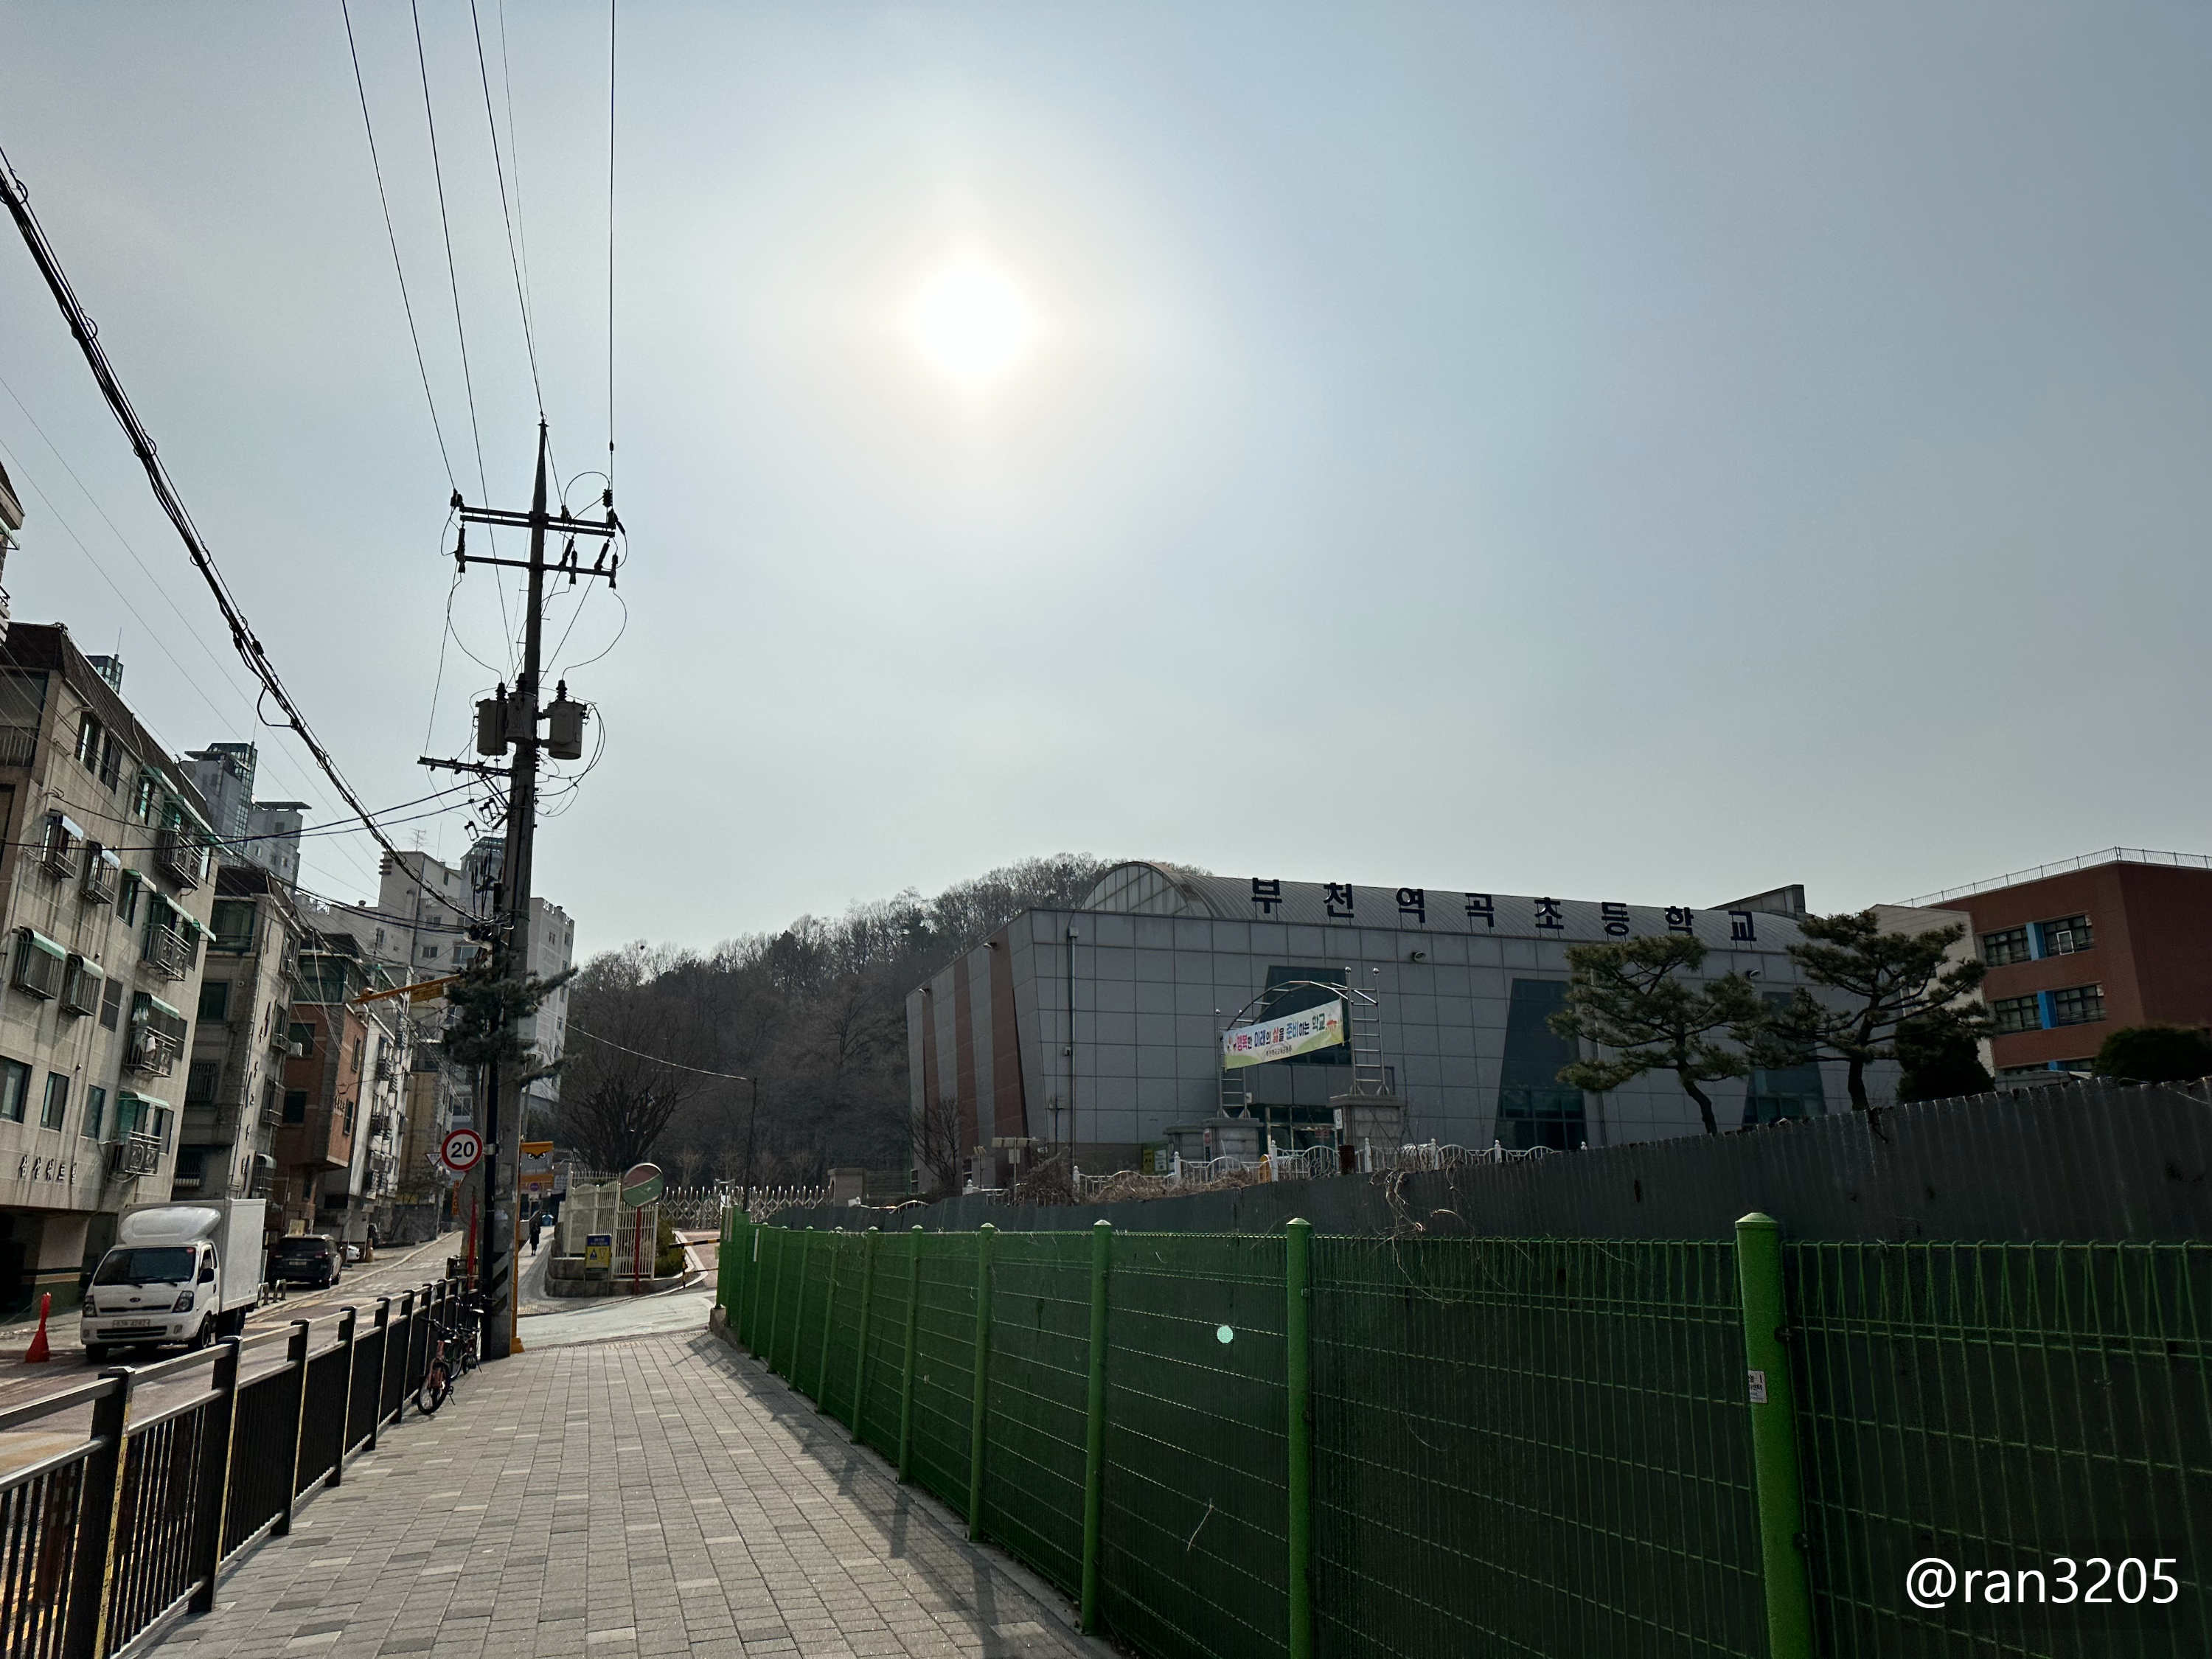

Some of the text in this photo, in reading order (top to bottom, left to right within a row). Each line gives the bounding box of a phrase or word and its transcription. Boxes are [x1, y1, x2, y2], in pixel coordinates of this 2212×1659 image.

[1251, 877, 1757, 942] 부천역곡초등학교
[1237, 1013, 1326, 1051] 행복한 미래의 삶을 준비하는 학교
[451, 1141, 475, 1158] 20
